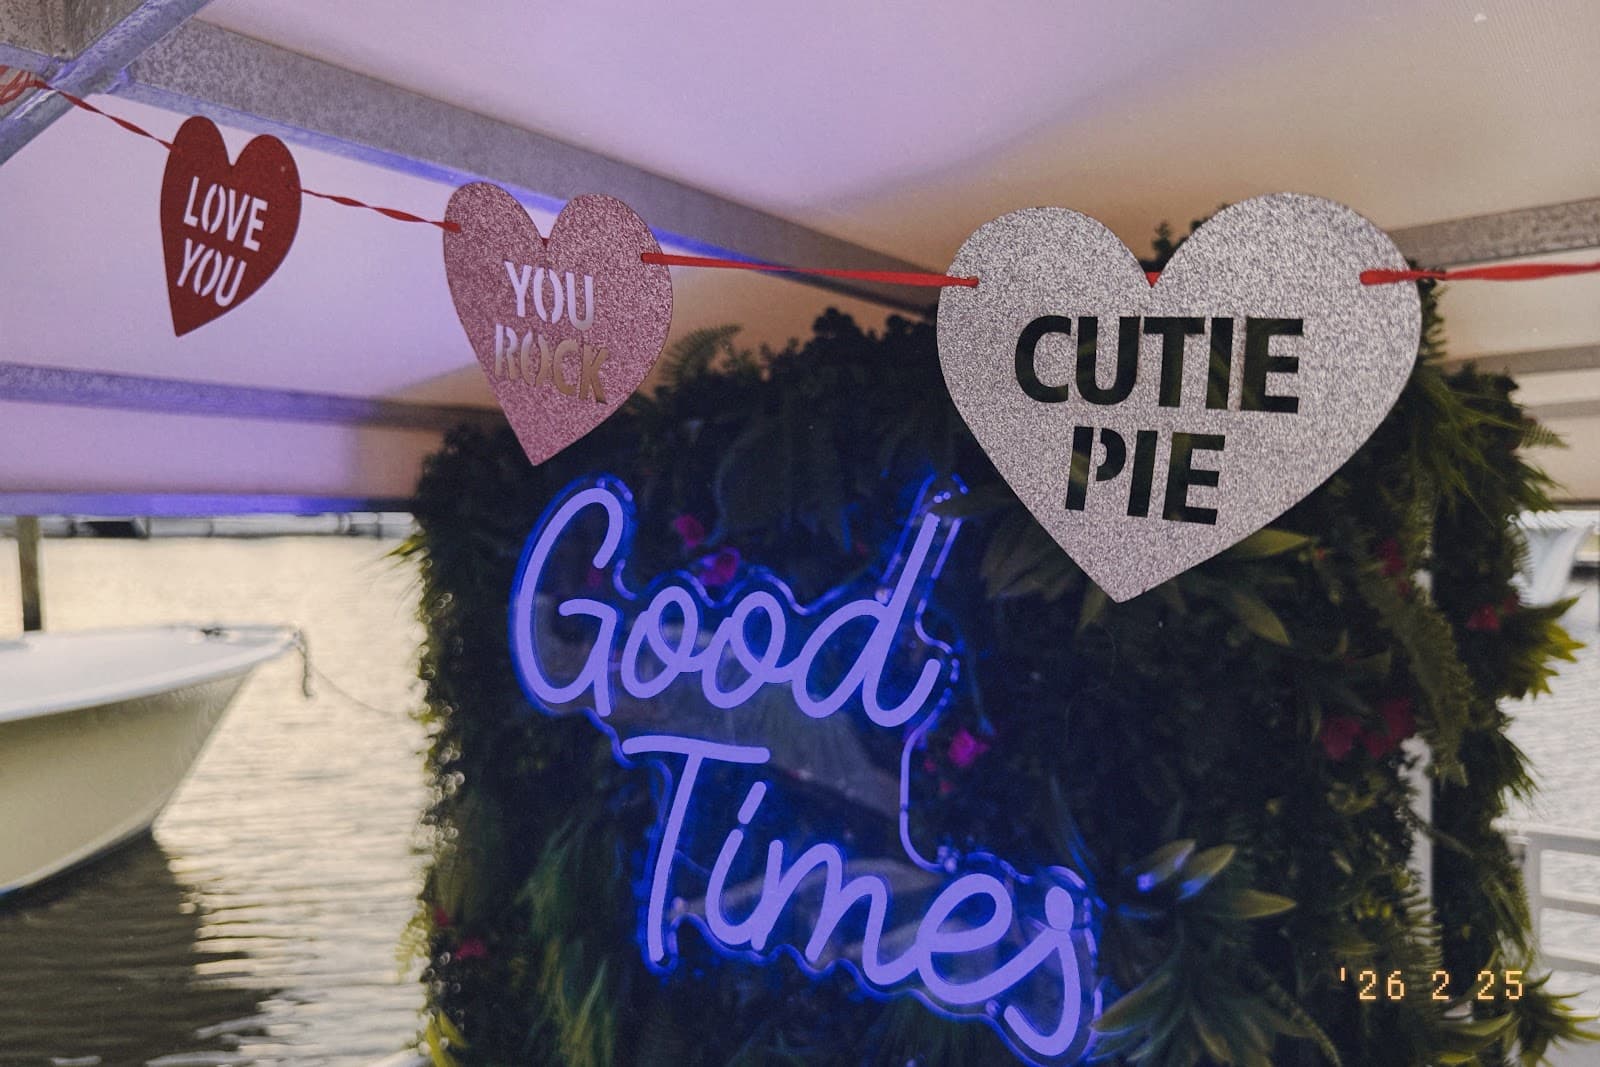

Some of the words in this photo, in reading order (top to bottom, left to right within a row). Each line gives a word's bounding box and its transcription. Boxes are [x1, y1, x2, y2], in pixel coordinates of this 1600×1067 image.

[184, 176, 268, 252] LOVE
[177, 238, 247, 307] YOU
[504, 260, 594, 331] YOU
[494, 323, 609, 405] ROCK
[1014, 314, 1304, 414] CUTIE
[1064, 426, 1226, 525] PIE
[516, 487, 942, 727] Good
[621, 735, 1083, 1057] Times
